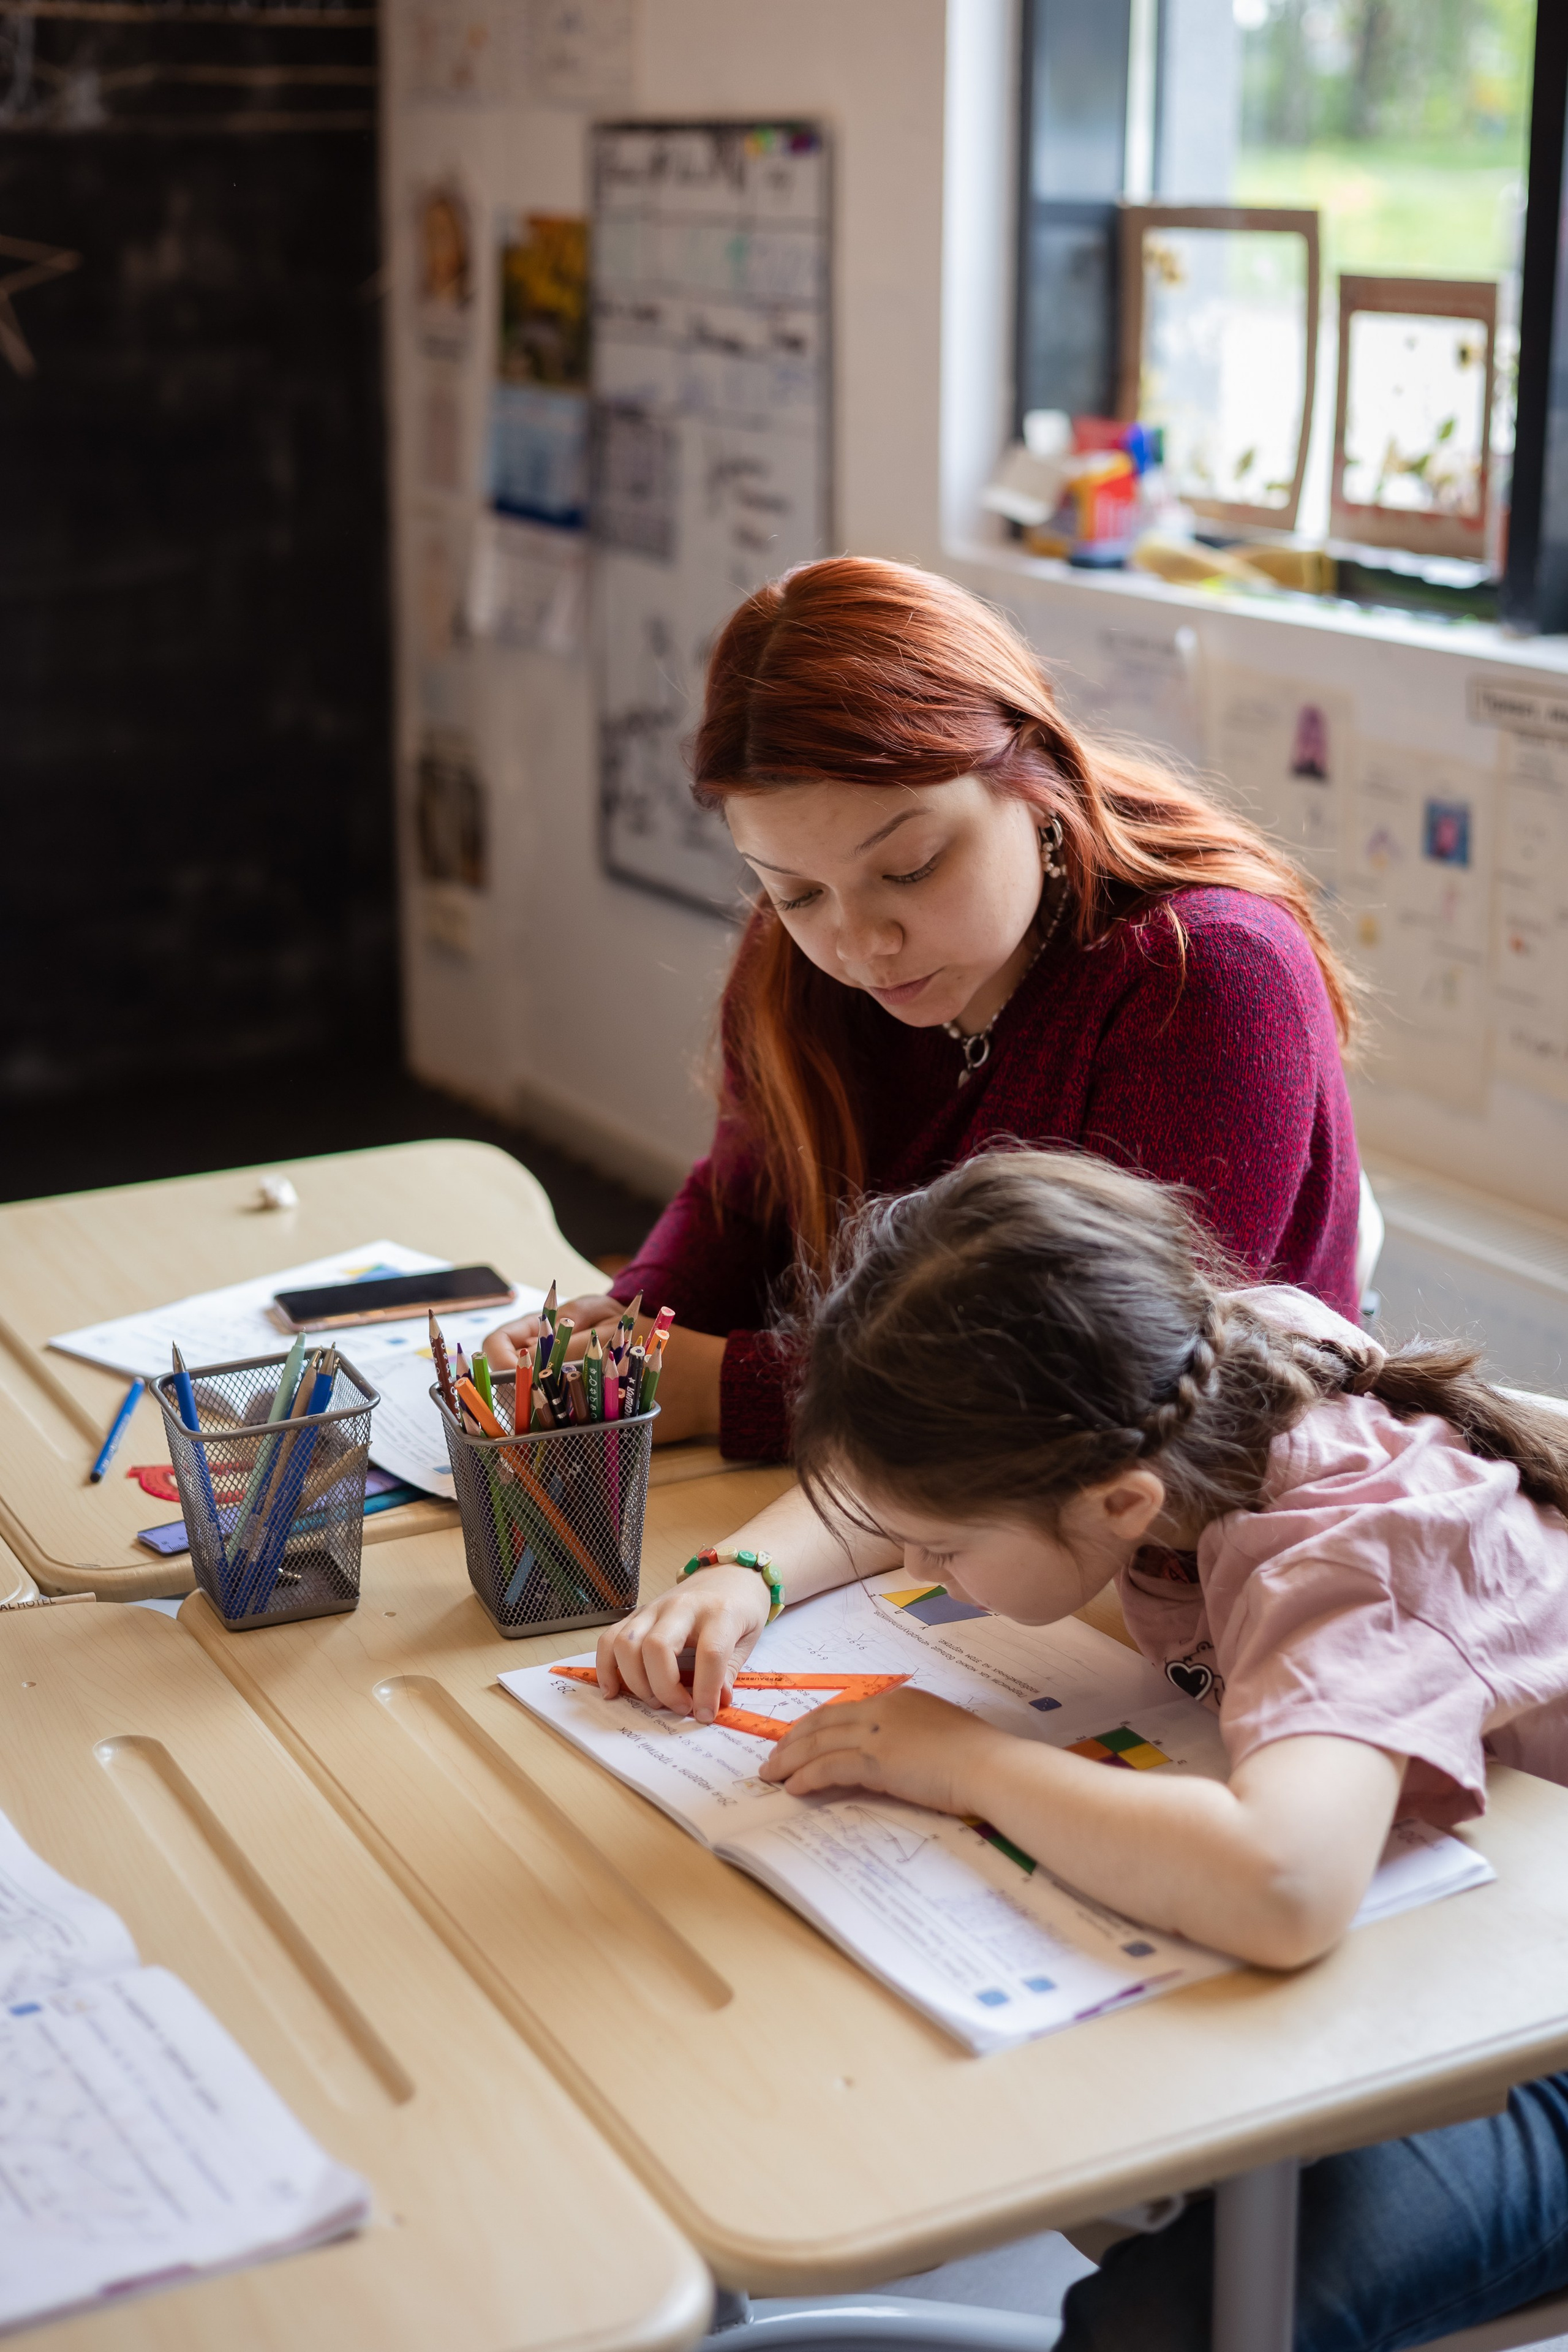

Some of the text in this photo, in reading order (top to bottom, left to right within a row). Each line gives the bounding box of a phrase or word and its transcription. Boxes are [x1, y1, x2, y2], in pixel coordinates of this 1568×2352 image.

[17, 1597, 57, 1609] HOTEL
[930, 1645, 956, 1660] больше
[964, 1653, 982, 1664] этом
[956, 1660, 979, 1672] можно
[550, 1680, 576, 1695] 29.3
[990, 1678, 1028, 1698] Перечисли
[653, 1719, 679, 1735] Прямой
[616, 1727, 738, 1807] 29-я неделя третий урок
